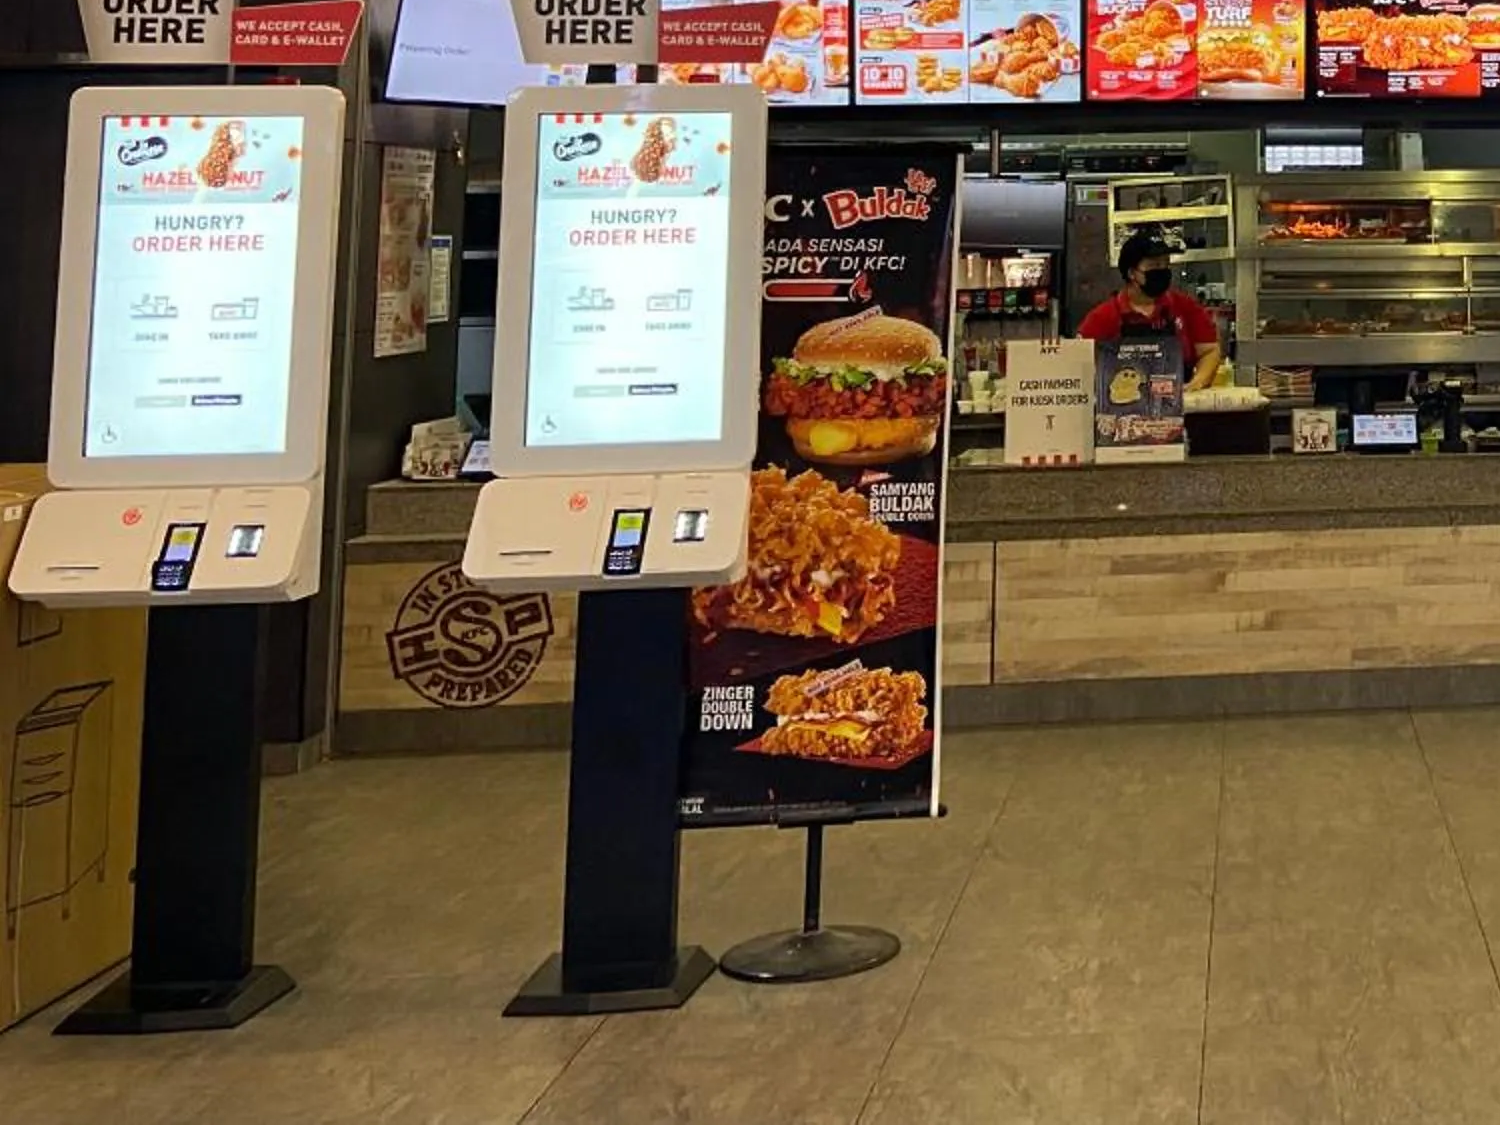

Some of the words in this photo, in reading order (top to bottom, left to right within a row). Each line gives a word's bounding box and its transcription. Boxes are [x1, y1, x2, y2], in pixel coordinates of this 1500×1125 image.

[113, 17, 206, 44] HERE
[236, 20, 256, 32] WE
[258, 20, 305, 32] ACCEPT
[544, 18, 633, 44] HERE
[663, 22, 680, 32] WE
[683, 22, 728, 32] ACCEPT
[235, 33, 268, 46] CARD
[283, 33, 347, 47] E-WALLET
[661, 35, 693, 46] CARD
[707, 35, 768, 46] E-WALLET
[142, 171, 197, 187] HAZEL
[822, 186, 931, 230] Buldak
[154, 215, 245, 232] HUNGRY?
[591, 209, 677, 225] HUNGRY?
[132, 235, 202, 253] ORDER
[209, 234, 264, 252] HERE
[569, 229, 636, 247] ORDER
[643, 227, 697, 245] HERE
[808, 238, 885, 253] SENSASI
[840, 256, 859, 270] DI
[863, 256, 906, 271] KFC!
[870, 482, 935, 497] SAMYANG
[869, 496, 934, 513] BULDAK
[424, 648, 535, 702] PREPARED
[703, 686, 755, 701] ZINGER
[701, 700, 753, 714] DOUBLE
[700, 714, 753, 731] DOWN
